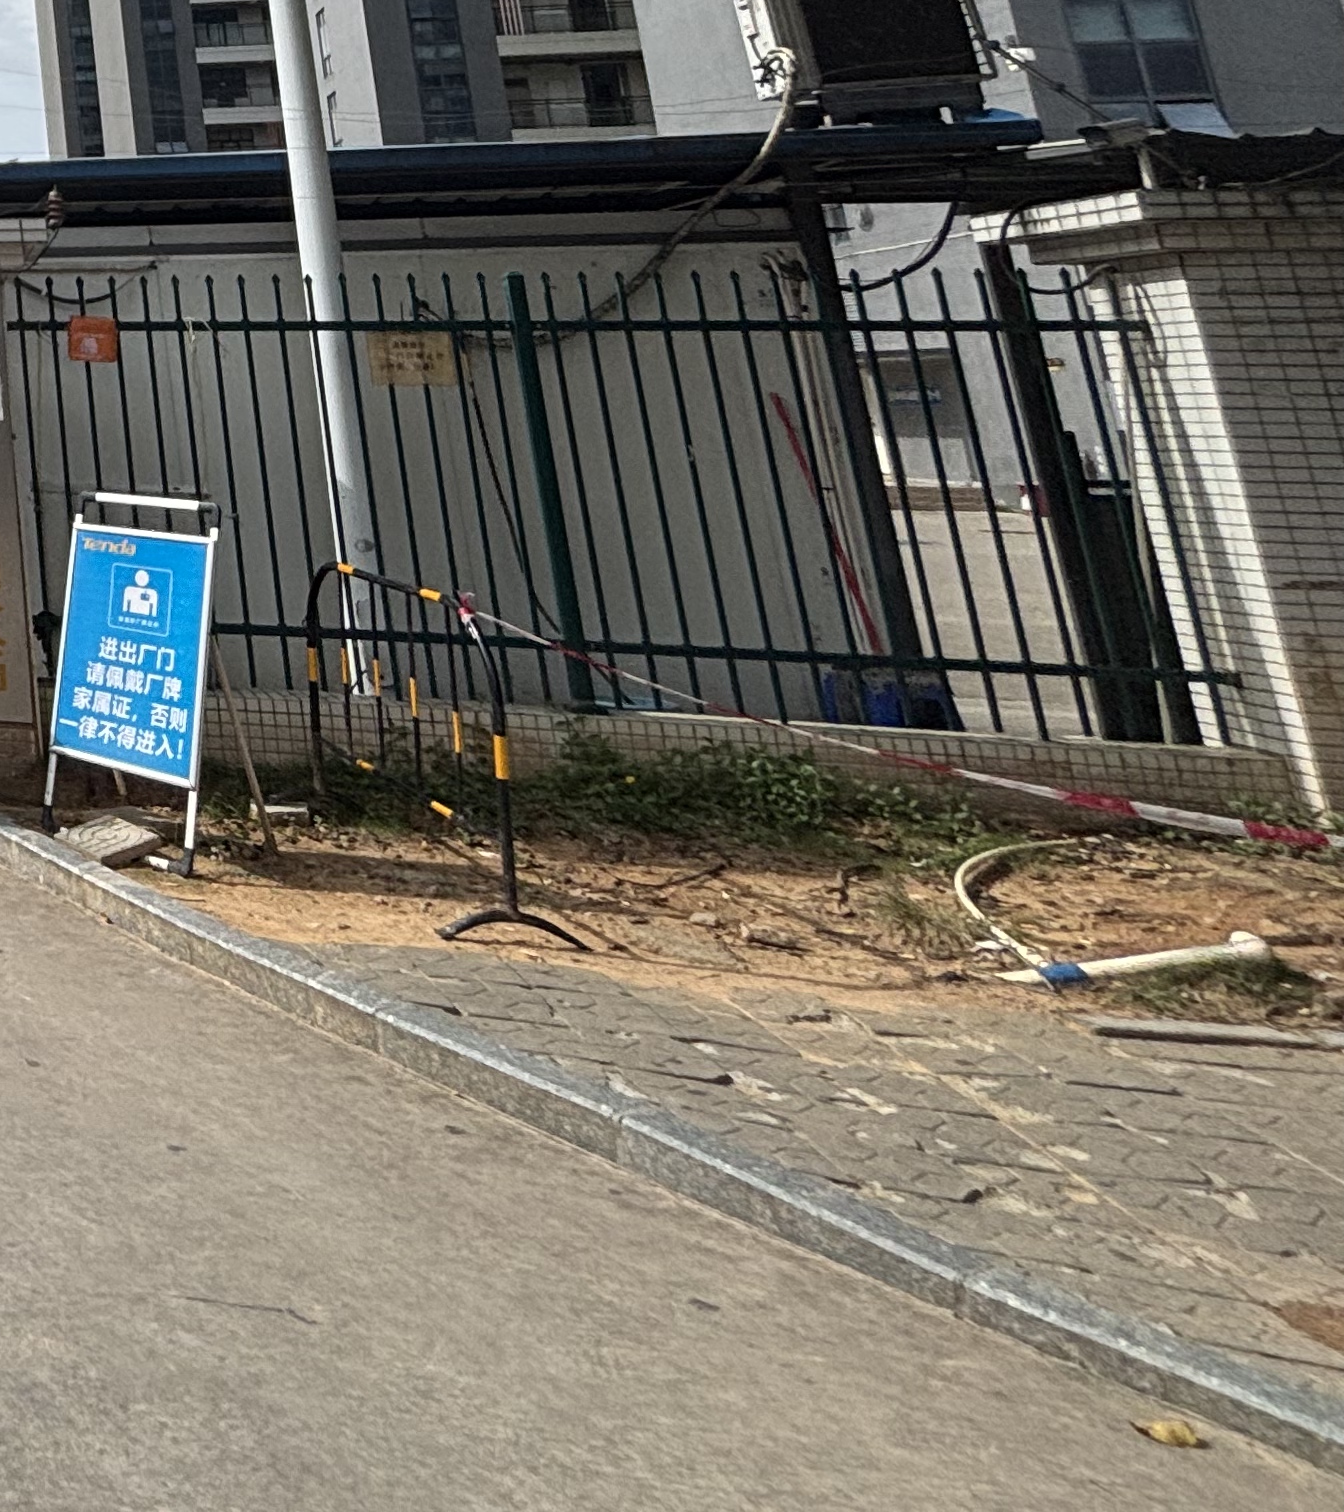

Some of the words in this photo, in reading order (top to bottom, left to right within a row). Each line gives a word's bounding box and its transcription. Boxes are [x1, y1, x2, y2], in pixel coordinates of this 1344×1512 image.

[82, 537, 136, 556] Tenda
[98, 636, 175, 672] 进出厂门
[86, 661, 182, 701] 请佩戴厂牌
